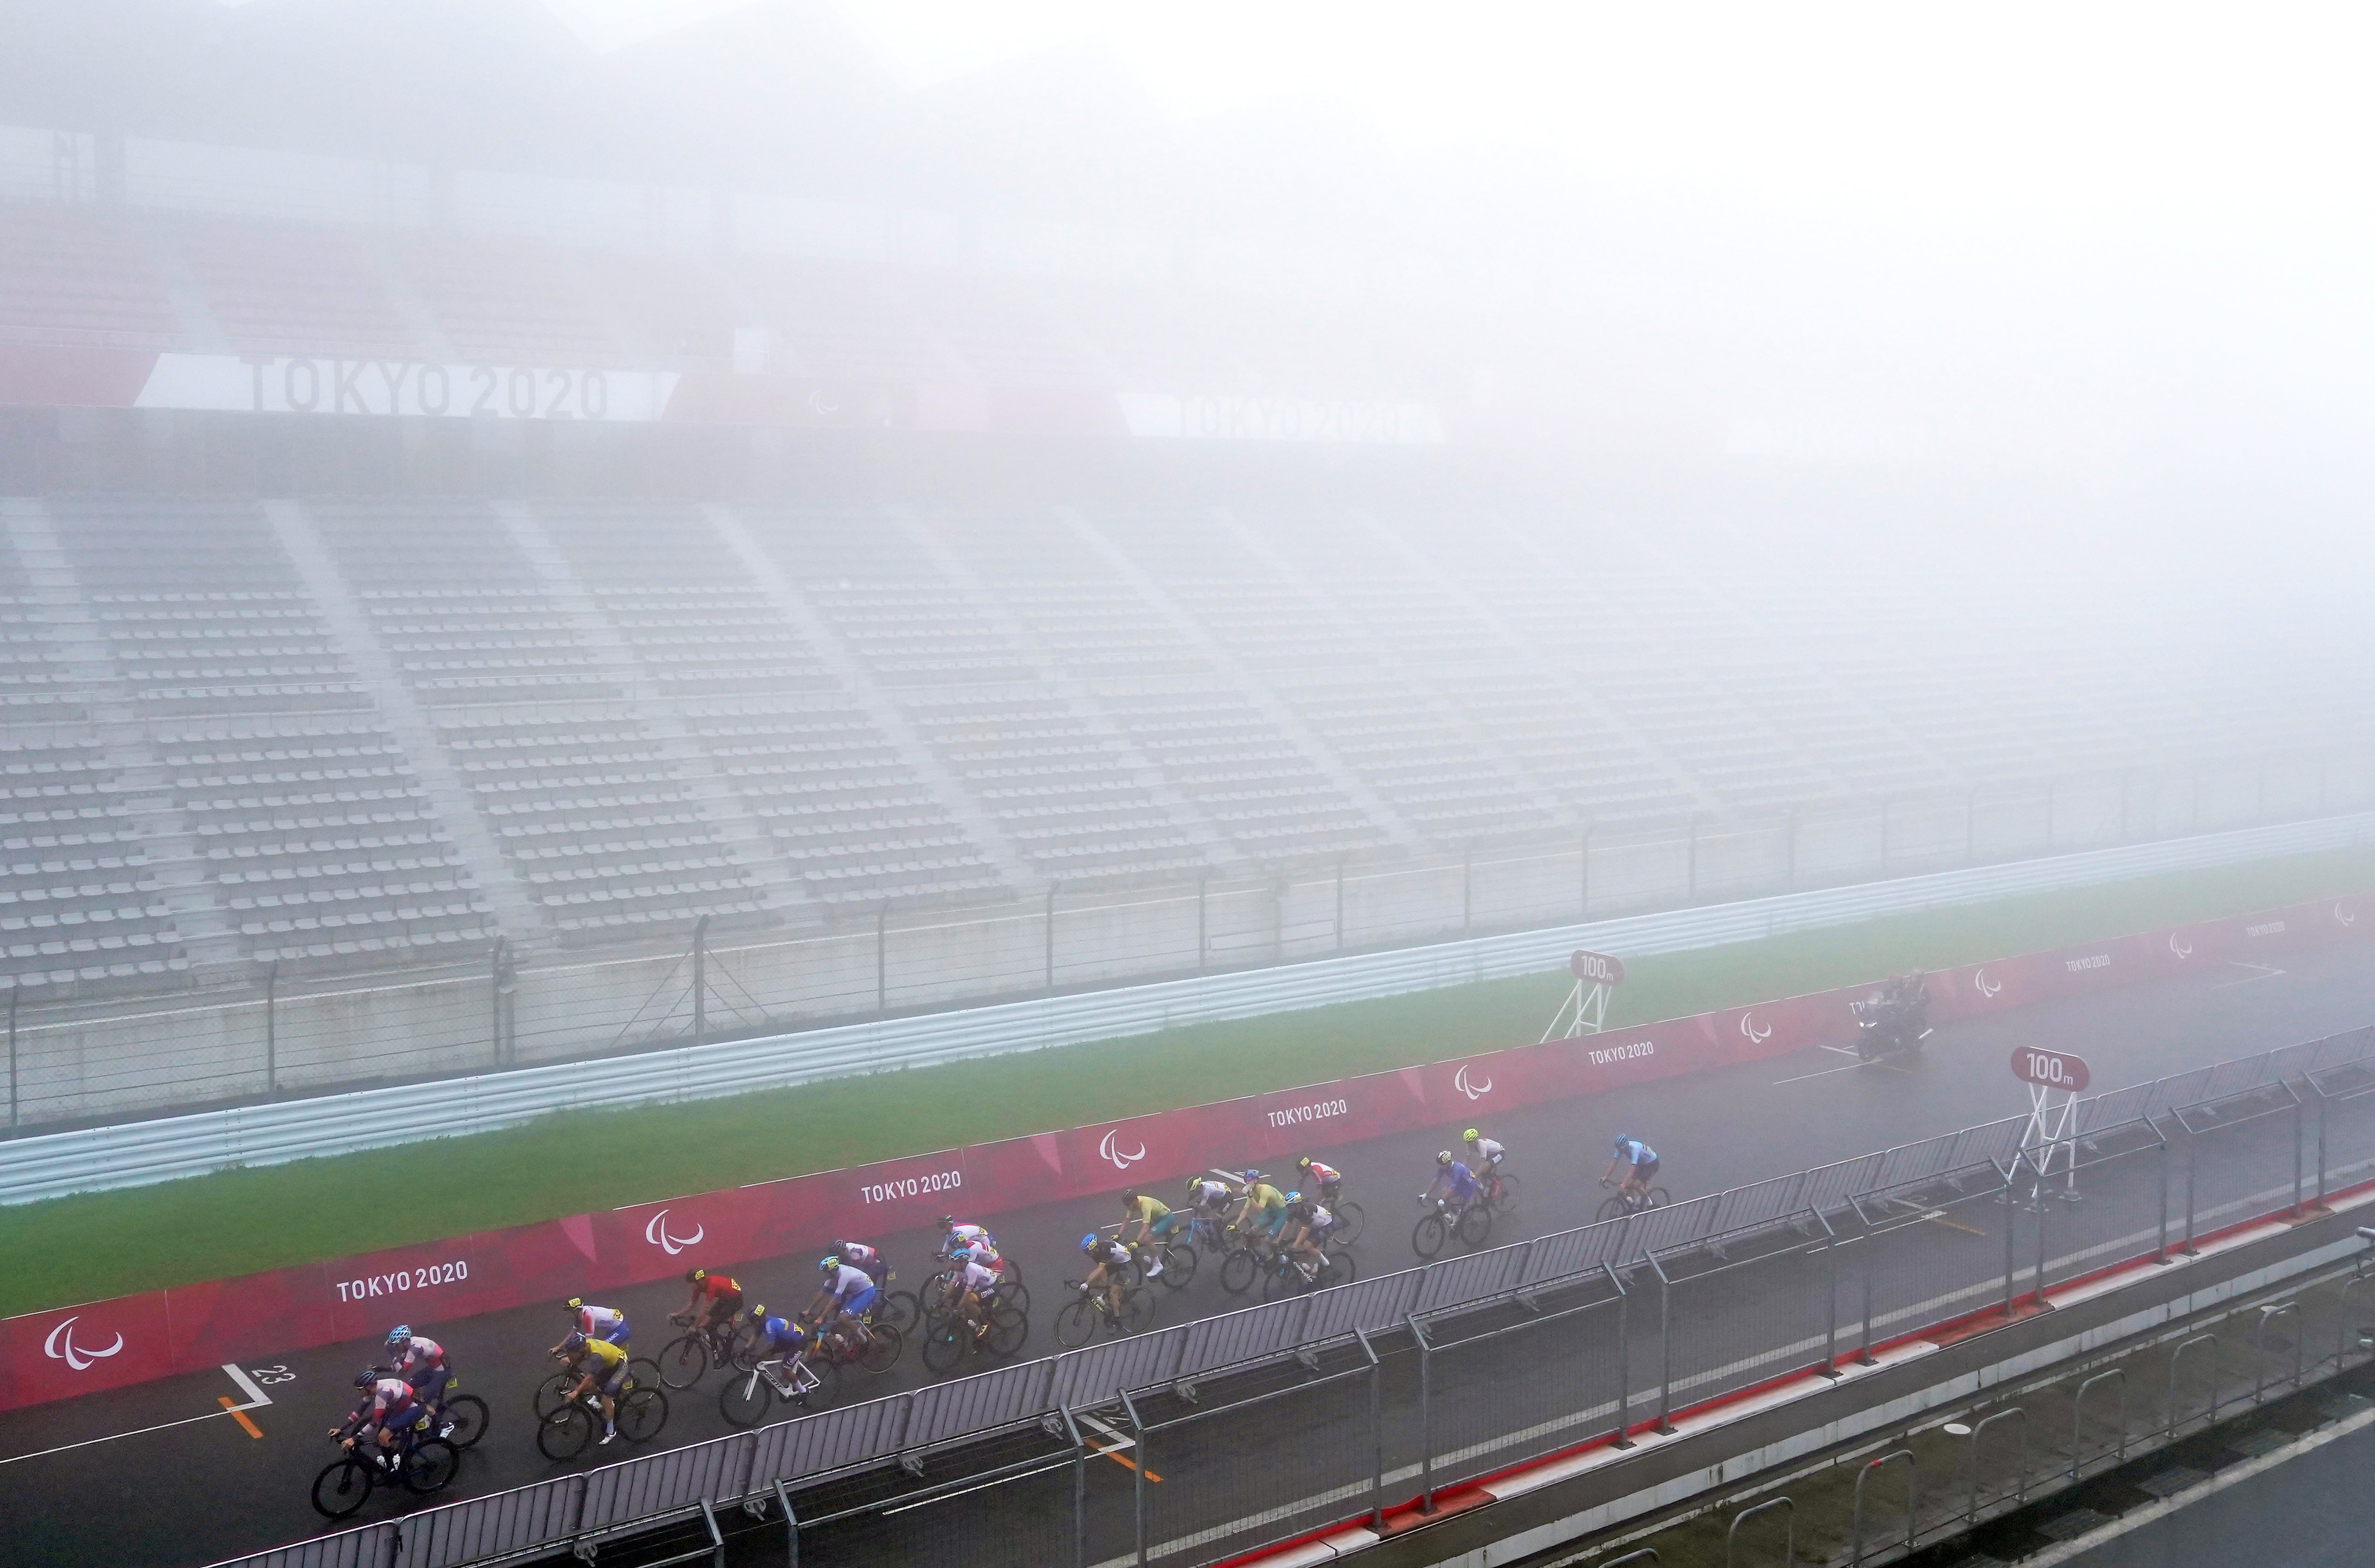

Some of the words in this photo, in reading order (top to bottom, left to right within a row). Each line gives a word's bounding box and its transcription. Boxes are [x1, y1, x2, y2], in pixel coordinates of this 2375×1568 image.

[239, 355, 451, 416] TOKYO
[469, 364, 608, 420] 2020
[1173, 395, 1301, 439] TOKYO
[1313, 400, 1400, 443] 2020
[2247, 923, 2268, 937] TOKYO
[2268, 921, 2285, 933] 2020
[2066, 958, 2091, 972] TOKYO
[2091, 954, 2110, 968] 2020
[1589, 1047, 1626, 1065] TOKYO
[1627, 1041, 1654, 1060] 2020
[1268, 1105, 1312, 1128] TOKYO
[1315, 1099, 1347, 1120] 2020
[861, 1179, 917, 1204] TOKYO
[921, 1170, 961, 1194] 2020
[337, 1271, 411, 1302] TOKYO
[415, 1260, 468, 1289] 2020
[251, 1365, 296, 1385] 23
